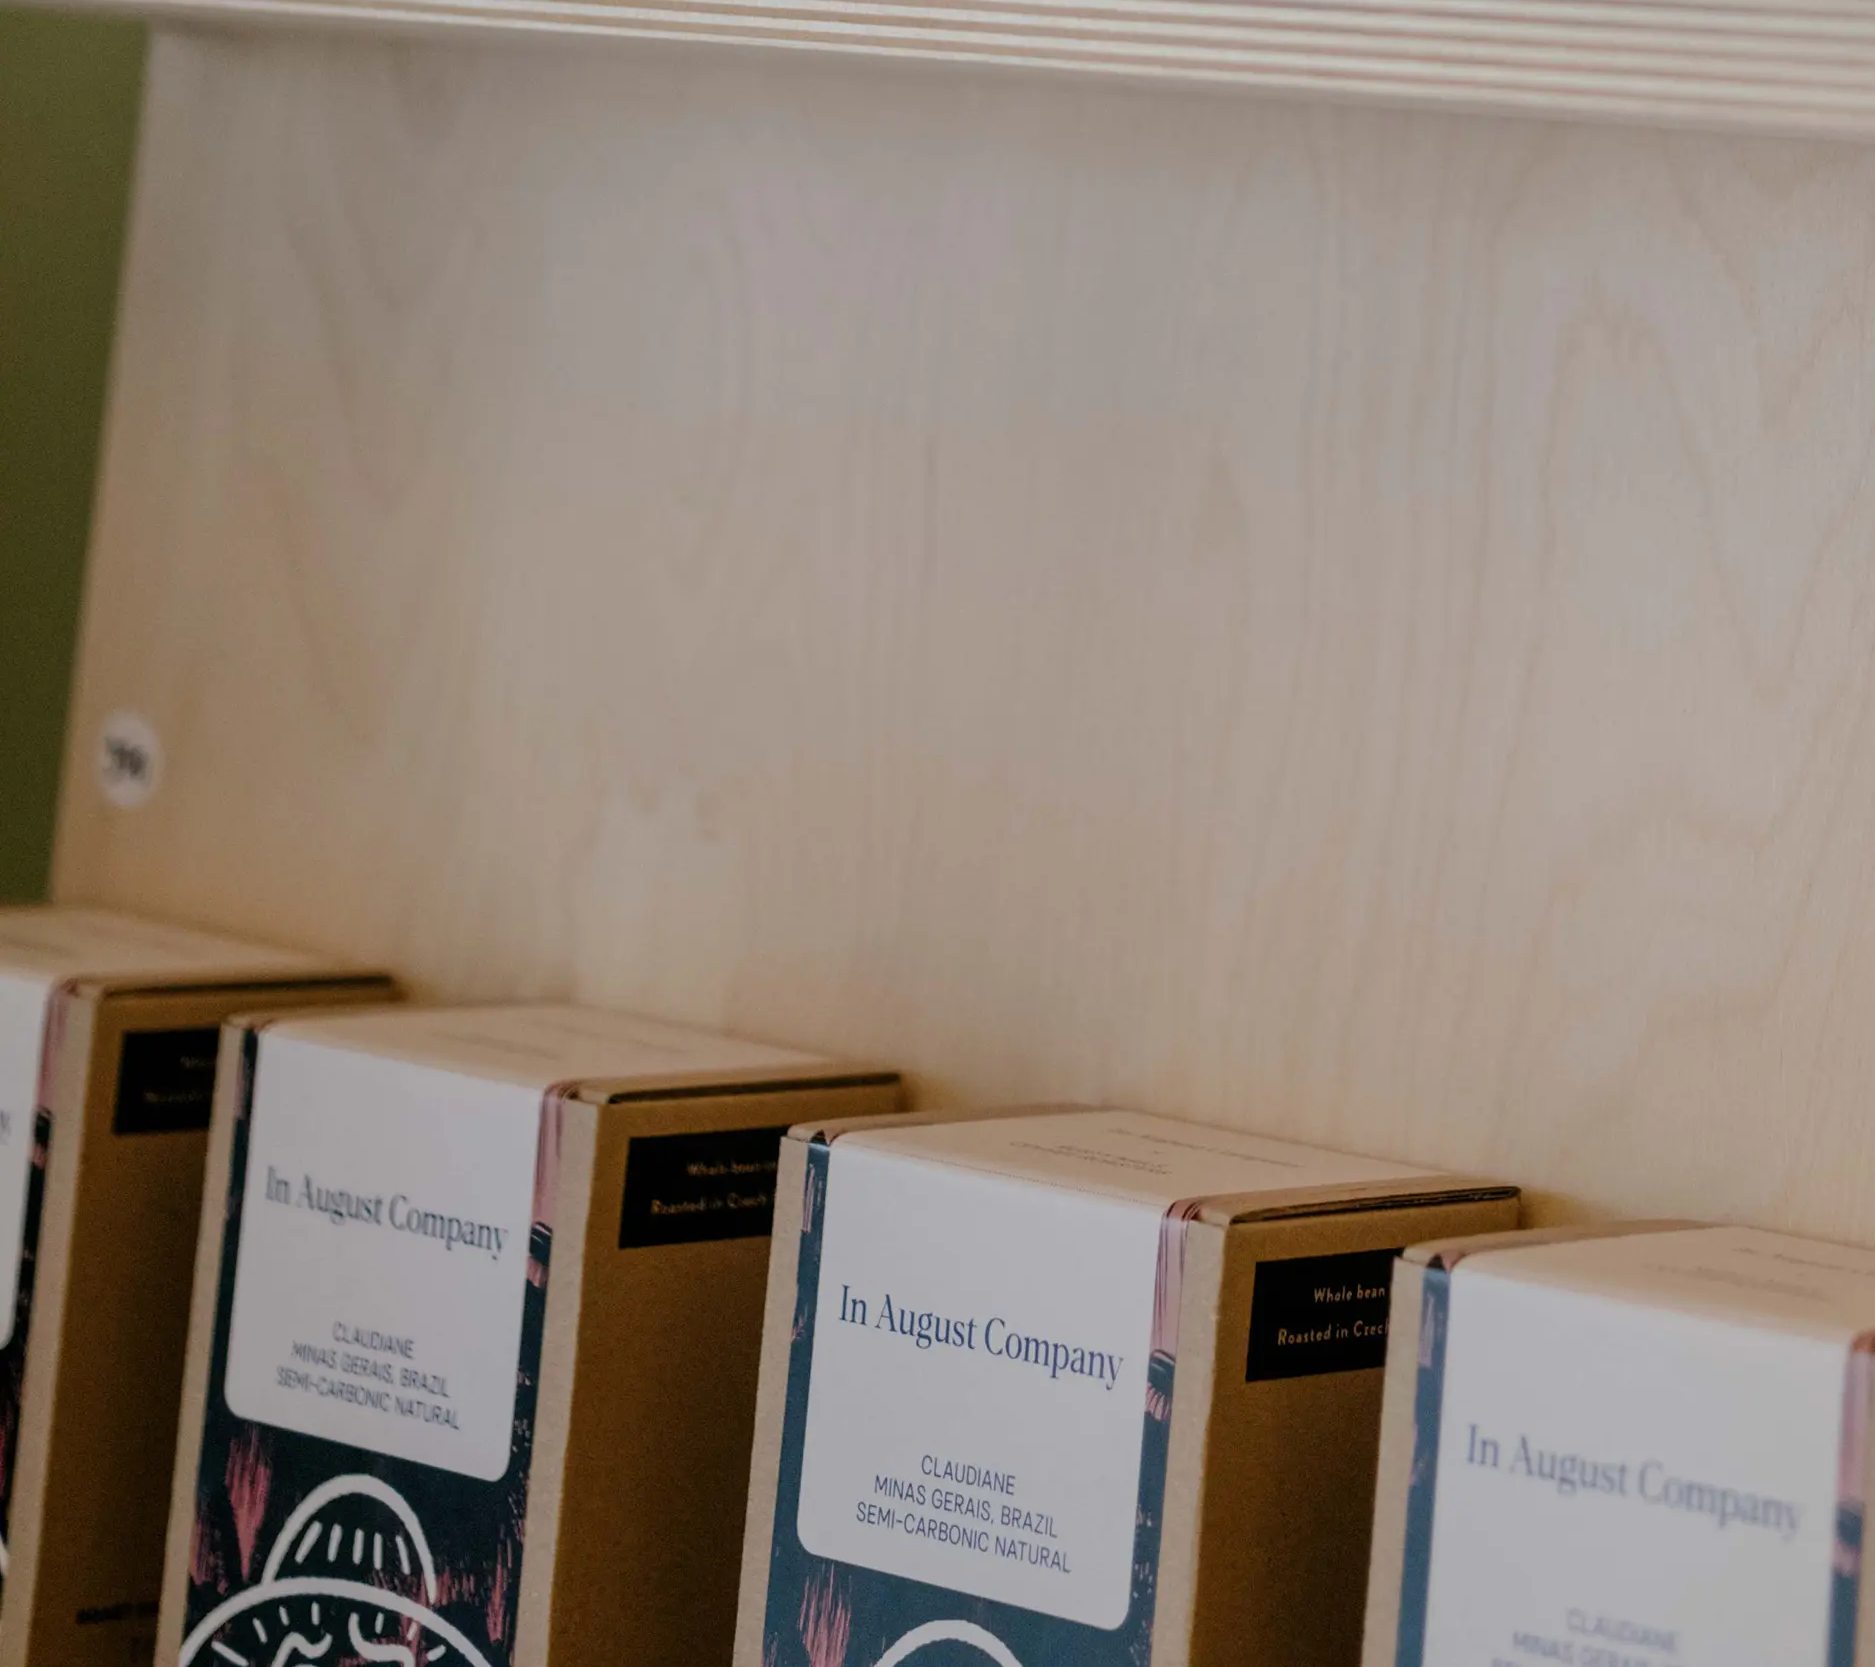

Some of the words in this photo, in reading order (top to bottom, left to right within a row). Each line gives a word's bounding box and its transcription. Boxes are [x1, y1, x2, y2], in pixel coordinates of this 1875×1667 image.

[265, 1165, 291, 1205] In
[296, 1173, 383, 1225] August
[389, 1193, 508, 1261] Company
[1314, 1284, 1352, 1303] Whole
[1356, 1283, 1386, 1299] bean
[332, 1321, 415, 1359] CLAUDIANE
[839, 1284, 868, 1326] In
[875, 1293, 977, 1349] August
[984, 1317, 1124, 1391] Company
[1277, 1323, 1332, 1346] Roasted
[1336, 1323, 1348, 1339] in
[276, 1365, 390, 1412] SEMI-CARBONIC
[395, 1396, 460, 1430] NATURAL
[291, 1339, 337, 1369] MINAS
[400, 1367, 450, 1398] BRAZIL
[874, 1474, 926, 1505] MINAS
[931, 1488, 994, 1524] GERAIS,
[1000, 1504, 1058, 1538] BRAZIL
[921, 1454, 1016, 1496] CLAUDIANE
[1466, 1423, 1499, 1468] In
[1509, 1433, 1628, 1498] August
[1637, 1459, 1804, 1544] Company
[856, 1501, 989, 1553] SEMI-CARBONIC
[994, 1535, 1071, 1574] NATURAL
